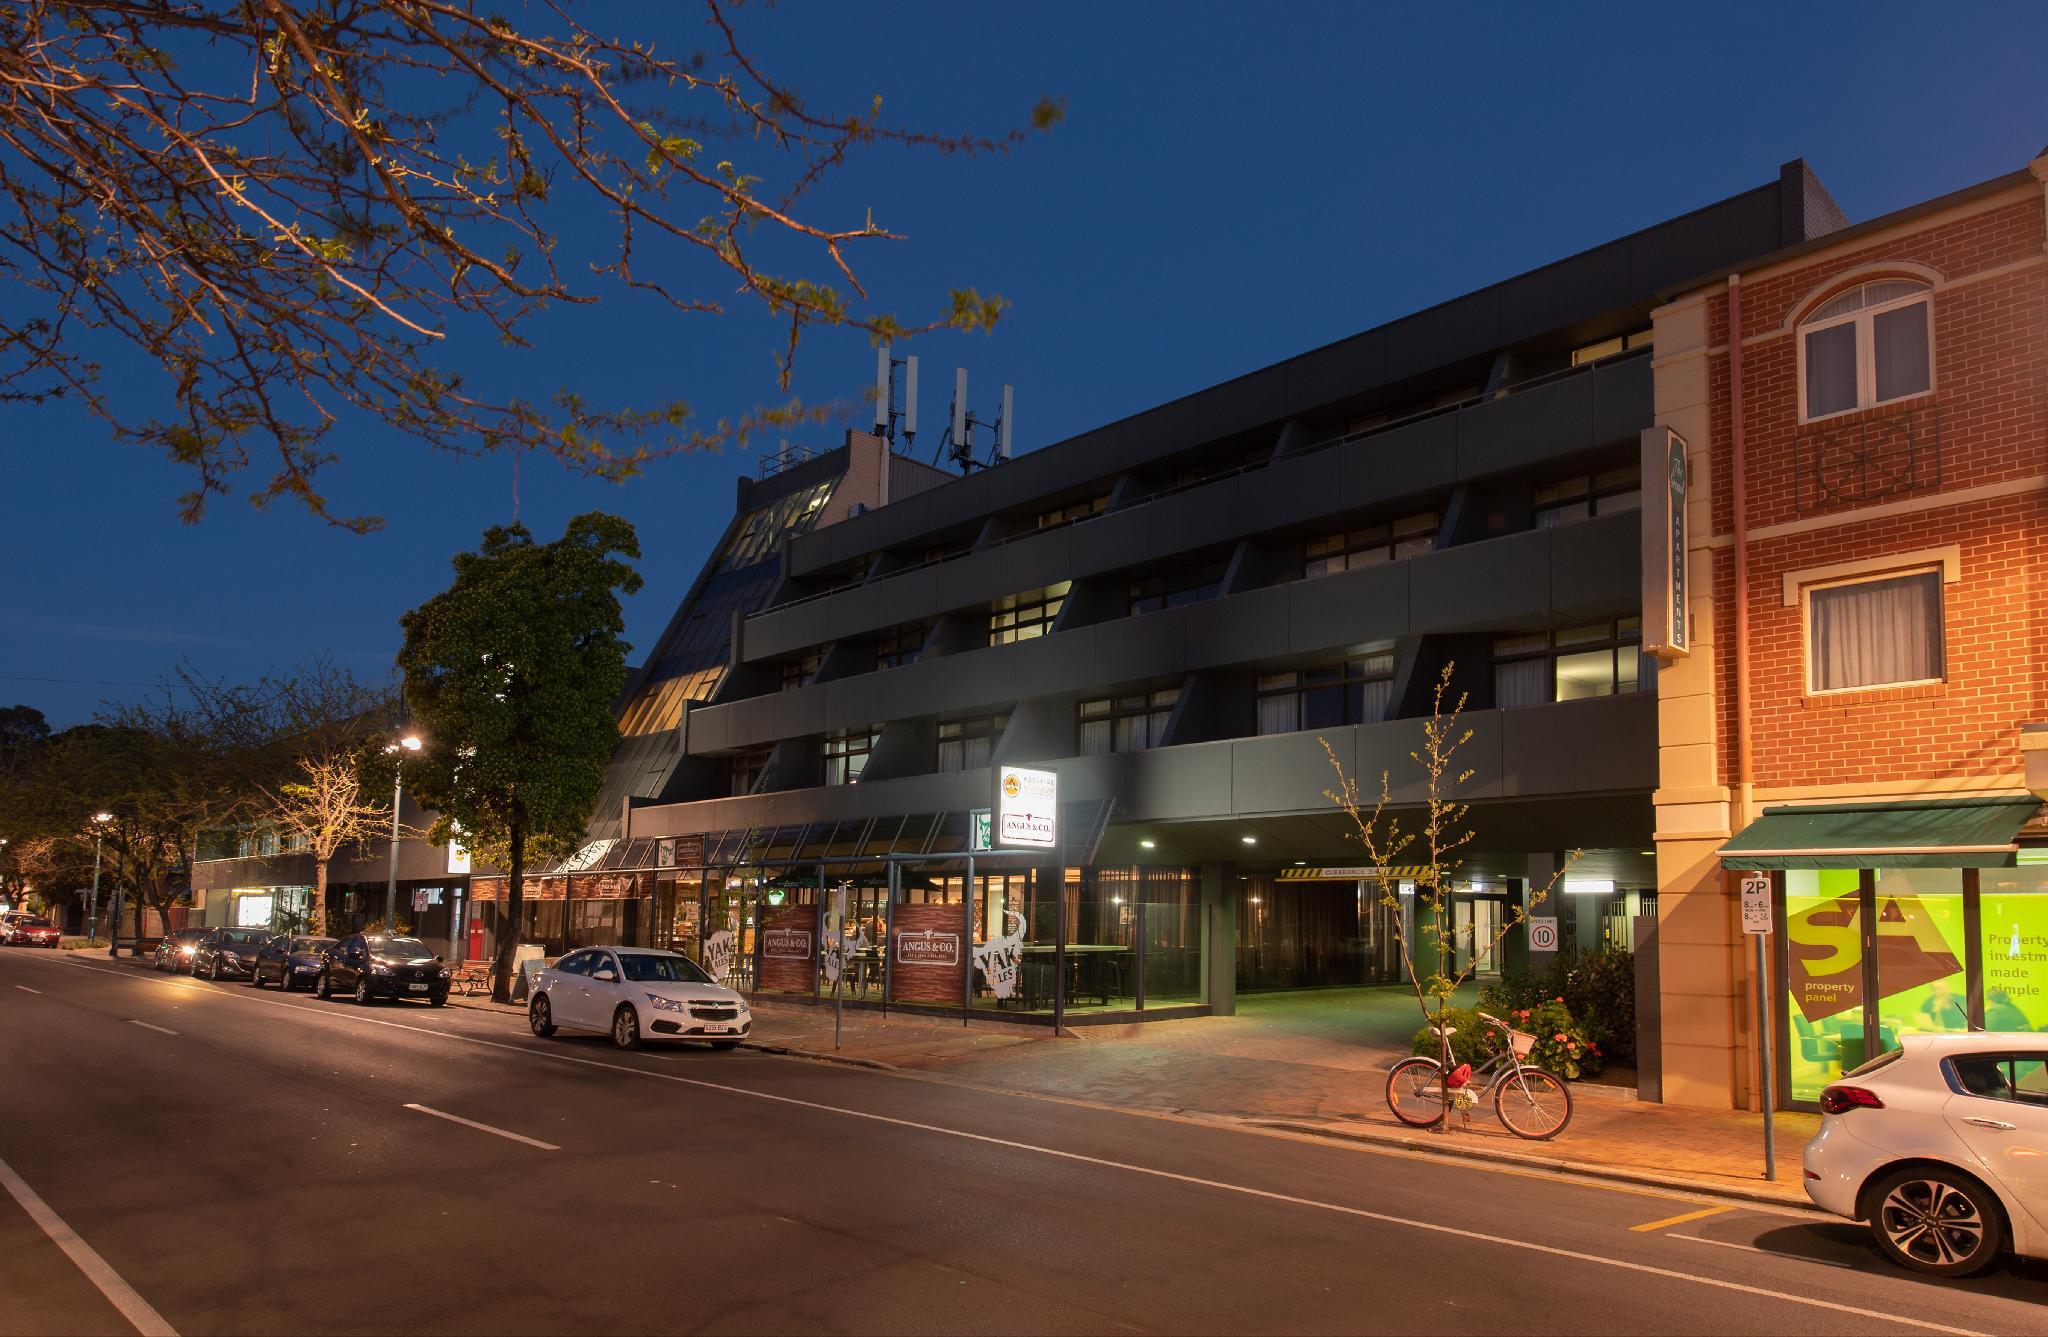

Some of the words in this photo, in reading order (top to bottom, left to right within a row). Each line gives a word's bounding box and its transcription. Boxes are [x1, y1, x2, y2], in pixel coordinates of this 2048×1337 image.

[1023, 776, 1054, 786] ADELAIDE
[1007, 822, 1031, 831] ANGUS
[1038, 824, 1051, 833] CO.
[1745, 881, 1767, 895] 2P
[1787, 868, 1954, 977] SA
[1537, 930, 1550, 943] 10
[707, 937, 733, 961] YAK
[767, 938, 790, 947] ANGUS
[790, 939, 795, 947] &
[796, 939, 808, 948] CO.
[902, 941, 931, 951] ANGUS
[931, 942, 939, 952] &
[939, 942, 954, 953] CO.
[979, 944, 1016, 971] YAK
[1990, 967, 2029, 978] made
[1805, 982, 1855, 993] property
[1991, 983, 2040, 997] simple
[1805, 994, 1837, 1003] panel
